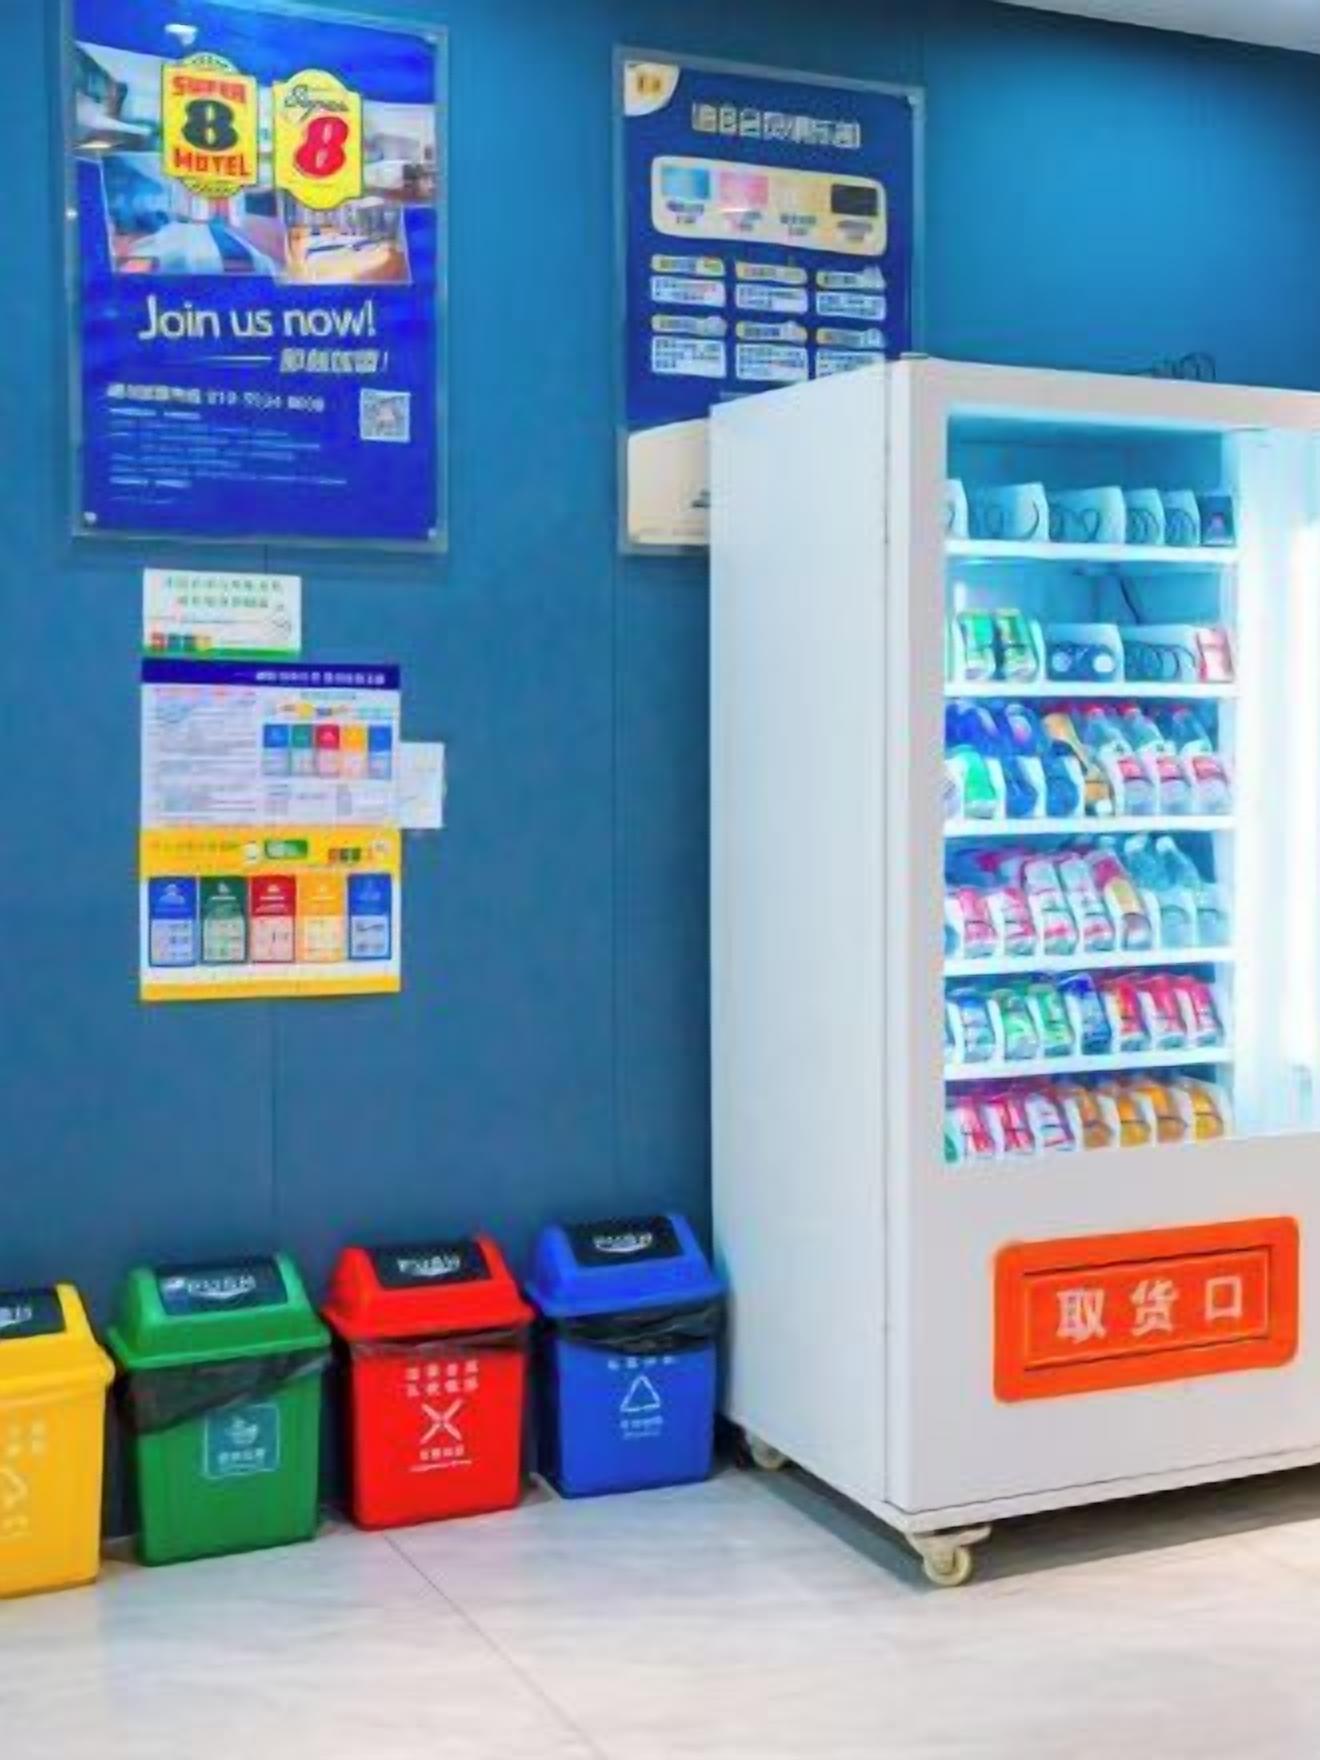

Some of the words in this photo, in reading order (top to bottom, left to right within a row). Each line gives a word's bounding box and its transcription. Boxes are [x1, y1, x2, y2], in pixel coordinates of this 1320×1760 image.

[182, 98, 240, 151] 8
[295, 115, 349, 178] 8
[138, 294, 220, 340] Join
[231, 308, 273, 338] us
[283, 299, 376, 338] now!
[1056, 1273, 1243, 1344] 取货口
